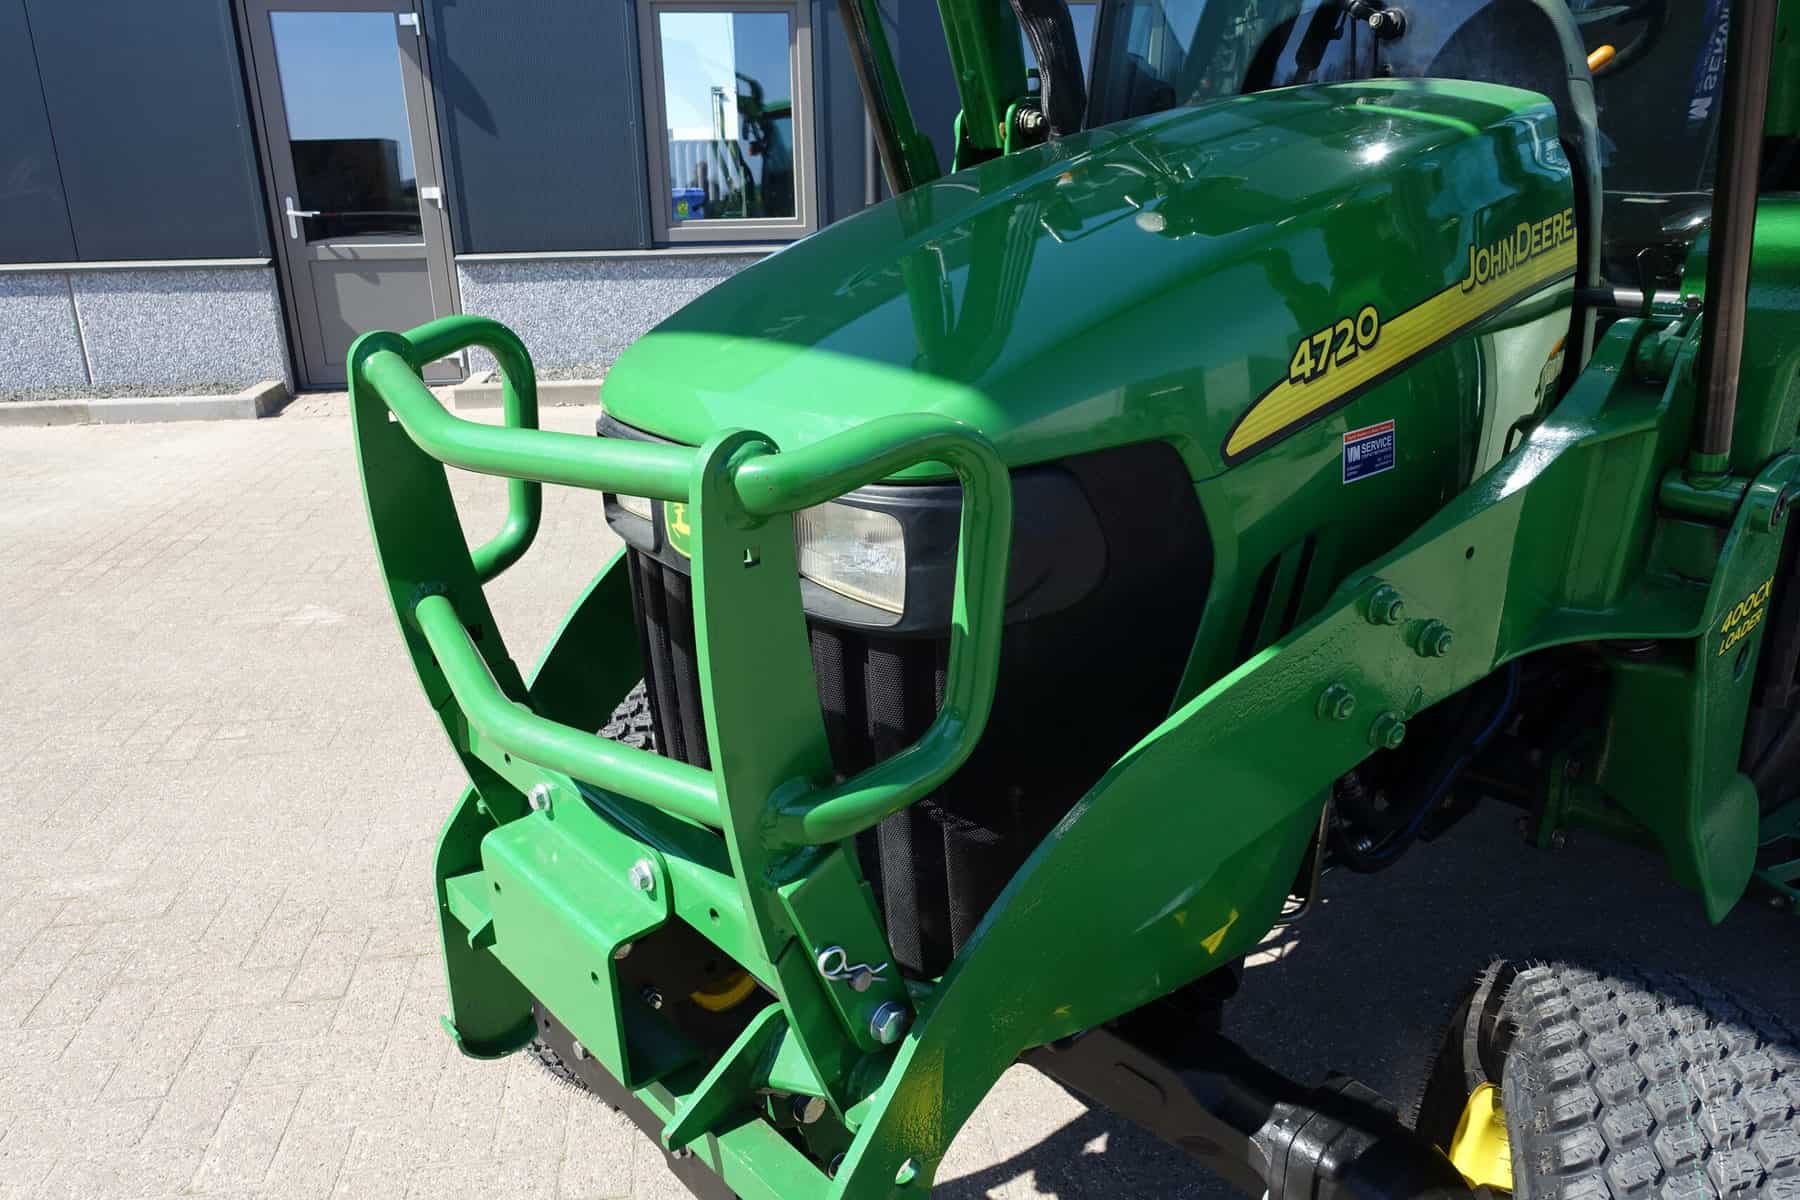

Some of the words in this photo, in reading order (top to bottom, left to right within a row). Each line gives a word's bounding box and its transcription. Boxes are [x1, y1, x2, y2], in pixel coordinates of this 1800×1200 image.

[1289, 305, 1379, 382] 4720
[1361, 435, 1393, 454] SERVICE
[1718, 607, 1764, 657] LOADER
